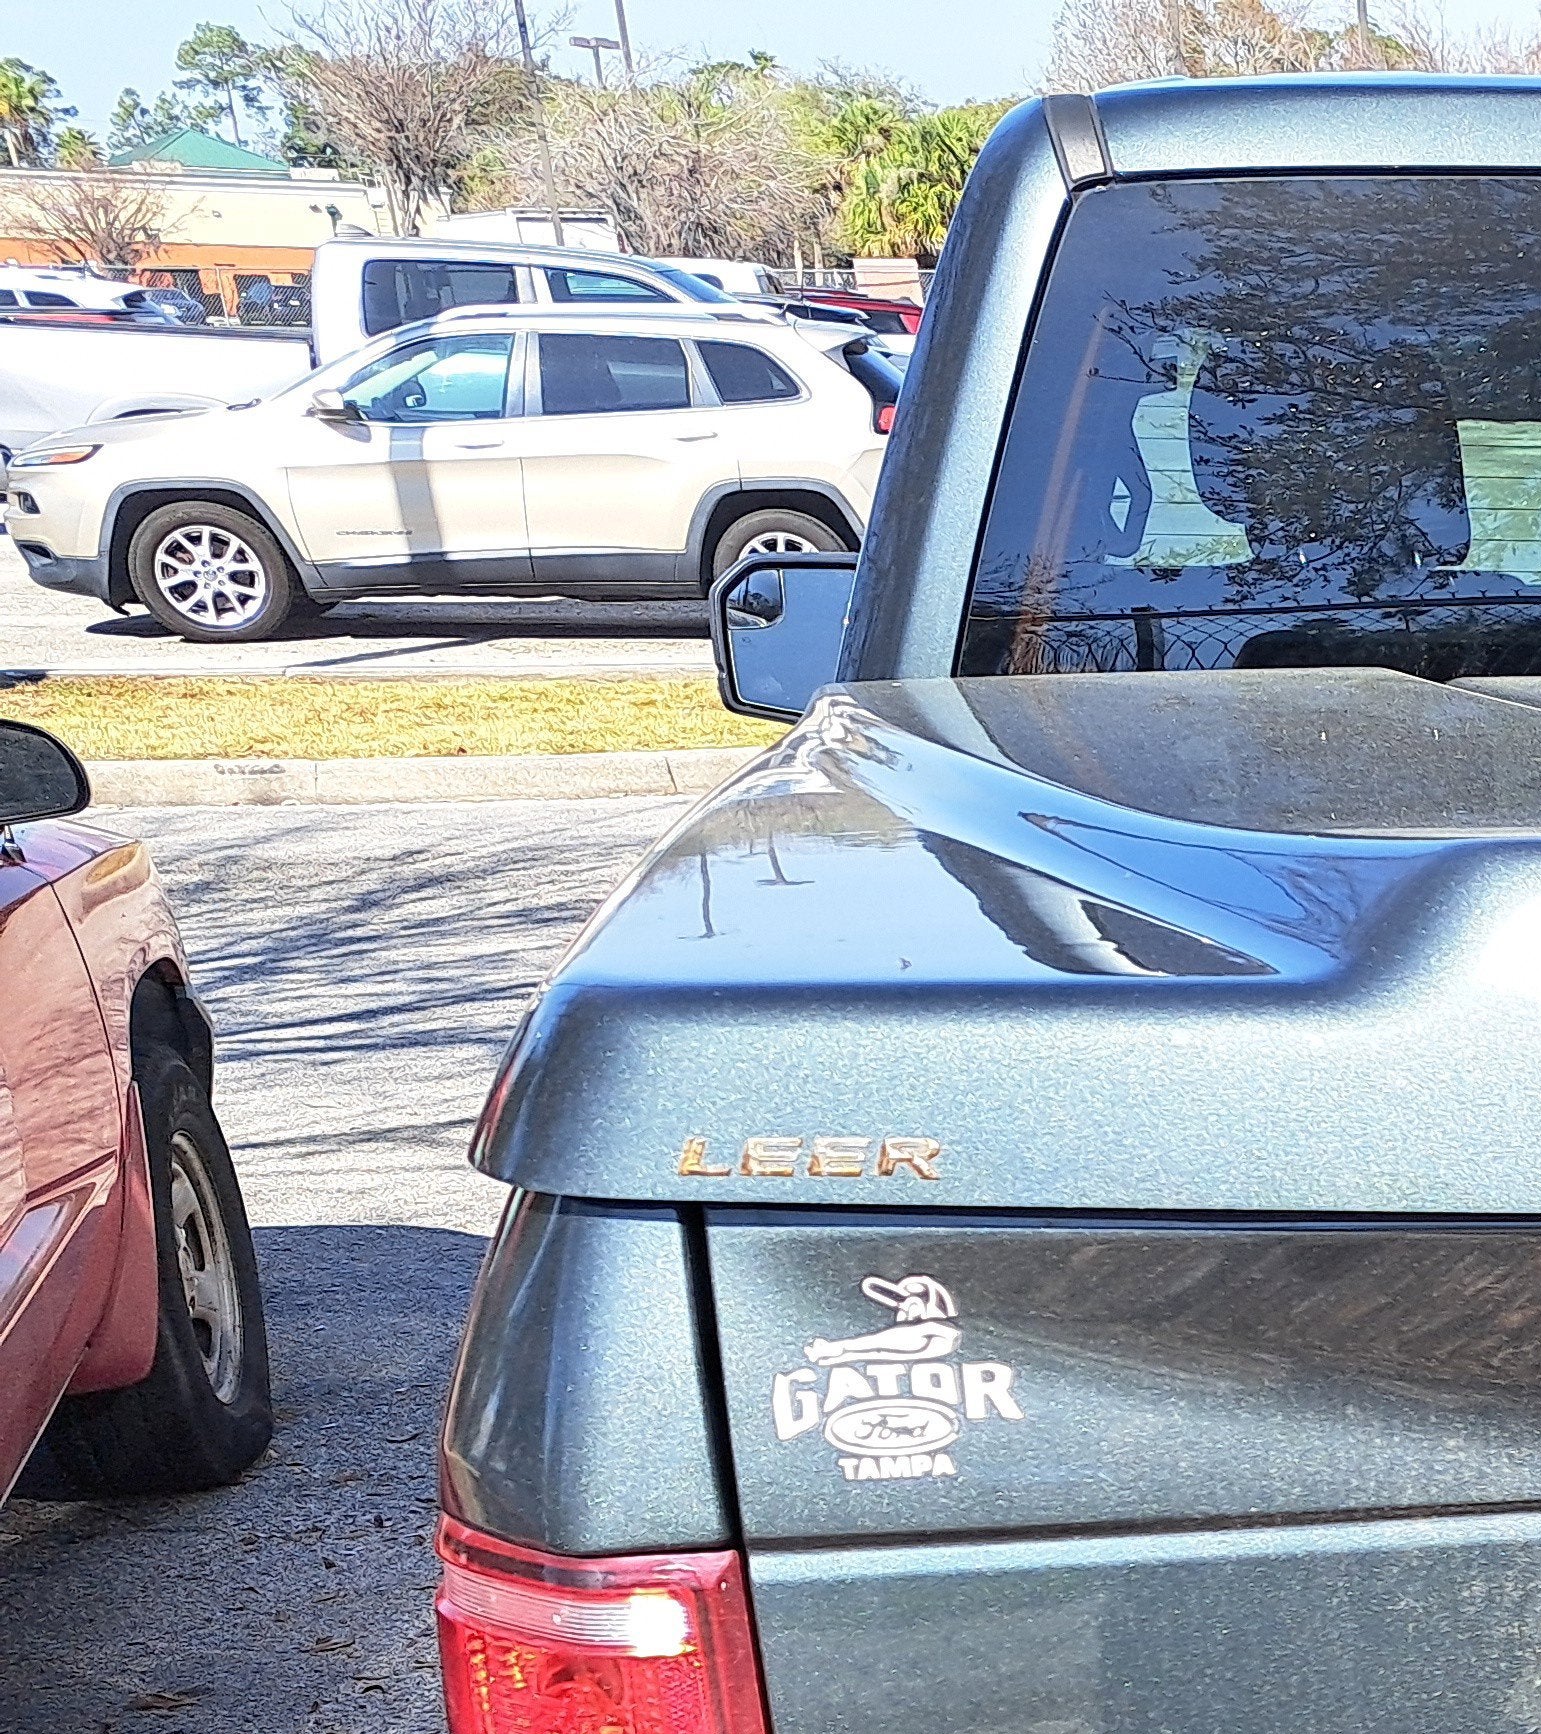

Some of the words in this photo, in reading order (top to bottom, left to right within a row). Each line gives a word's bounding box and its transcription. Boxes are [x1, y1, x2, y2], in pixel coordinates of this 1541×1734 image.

[677, 1136, 942, 1180] LEER
[773, 1361, 1026, 1441] GATOR
[855, 1414, 929, 1440] Ford
[839, 1453, 956, 1480] TAMPA
